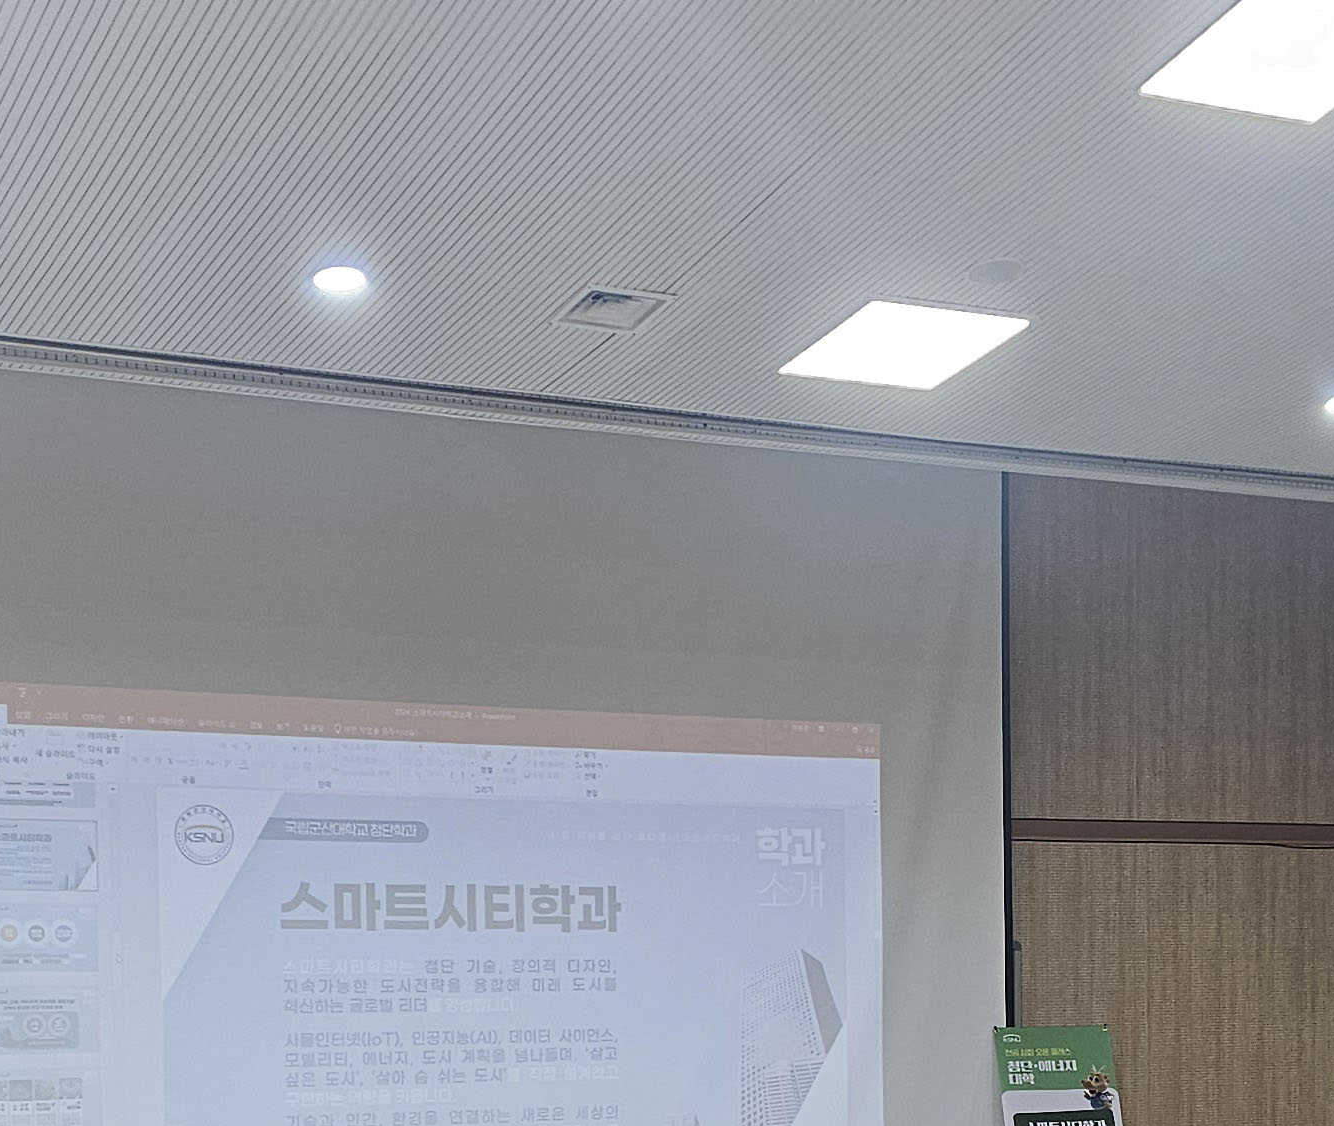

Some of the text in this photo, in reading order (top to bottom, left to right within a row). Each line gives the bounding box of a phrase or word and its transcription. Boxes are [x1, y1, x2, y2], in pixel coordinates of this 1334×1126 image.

[183, 831, 225, 845] KSNU
[284, 820, 418, 838] 국립군산대학교 첨단학과
[757, 826, 825, 867] 학과
[757, 870, 825, 910] 소개
[280, 880, 623, 933] 스마트시티학과
[424, 959, 455, 975] 첨단
[466, 959, 502, 976] 기술,
[512, 958, 556, 975] 창의적
[566, 958, 618, 976] 디자인,
[283, 976, 618, 995] 지속가능한 도시전략을 융합해 미래 도시를
[283, 998, 344, 1014] 혁신하는
[349, 998, 394, 1014] 글로벌
[284, 1027, 619, 1049] 사물인터넷(IoT), 인공지능(AI), 데이터 사이언스,
[284, 1051, 354, 1069] 모빌리티,
[363, 1050, 414, 1067] 에너지,
[422, 1049, 452, 1066] 도시
[461, 1048, 506, 1064] 계획을
[514, 1047, 579, 1064] 넘나들며,
[1007, 1059, 1078, 1073] 첨단·에너지
[285, 1071, 316, 1088] 싶은
[414, 1069, 429, 1085] 숨
[437, 1068, 466, 1084] 쉬는
[1008, 1073, 1036, 1086] 대학
[391, 1110, 439, 1126] 환경을
[448, 1109, 511, 1125] 연결하는
[520, 1106, 566, 1123] 새로운
[575, 1105, 619, 1121] 세상의
